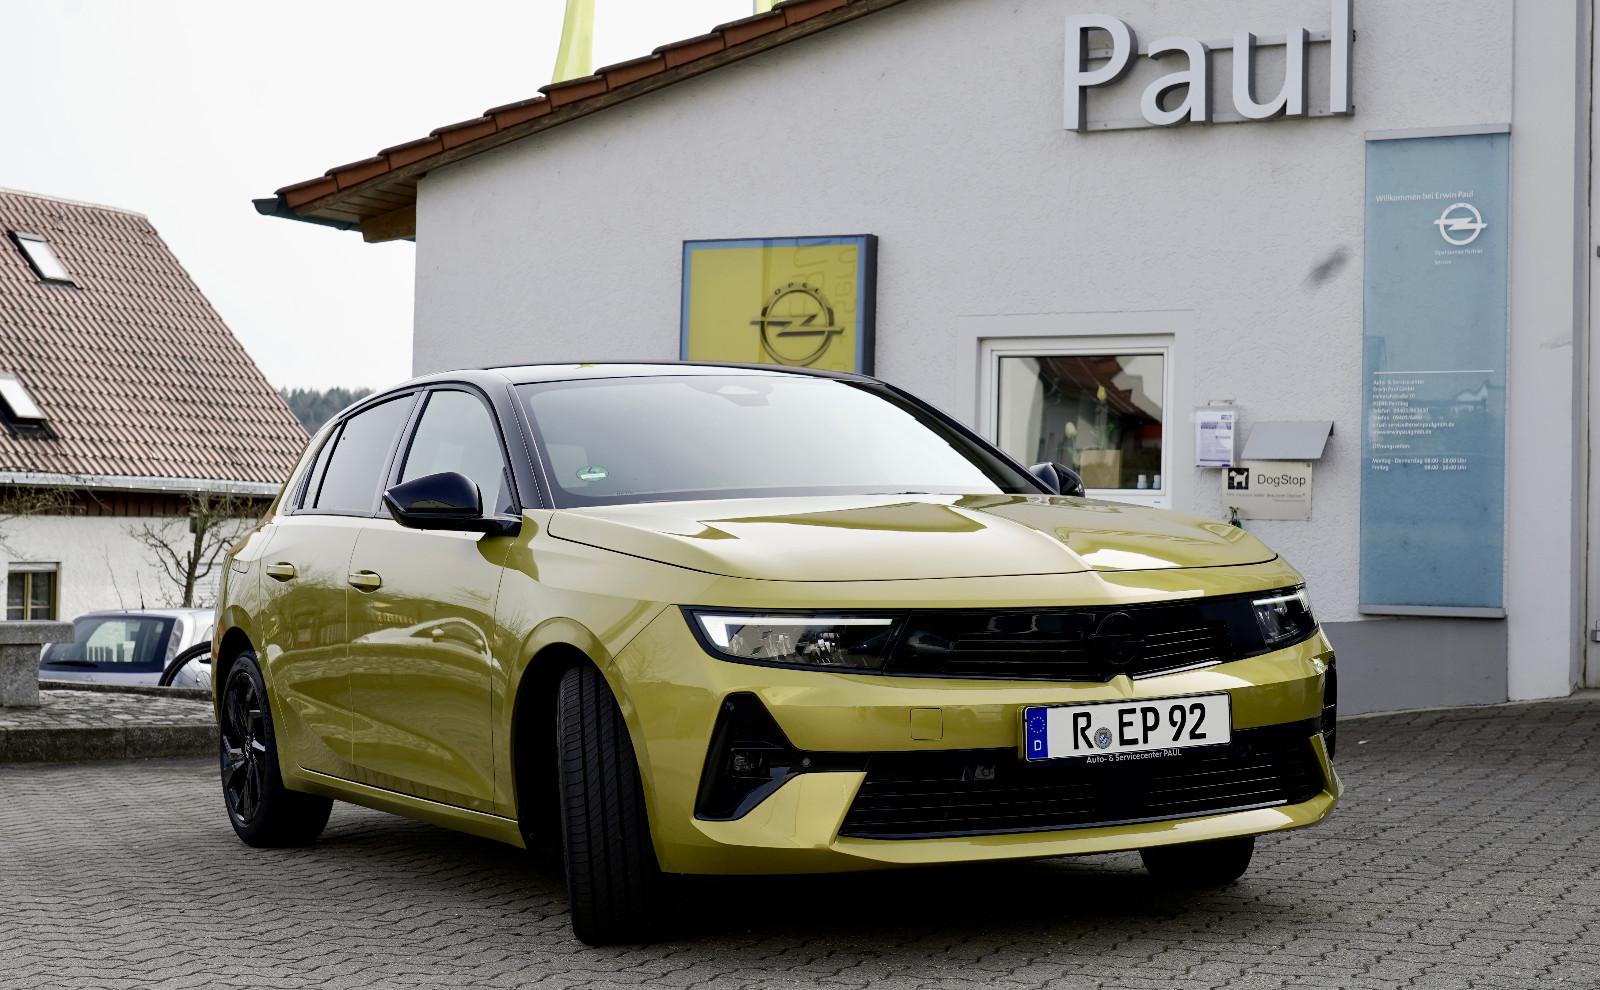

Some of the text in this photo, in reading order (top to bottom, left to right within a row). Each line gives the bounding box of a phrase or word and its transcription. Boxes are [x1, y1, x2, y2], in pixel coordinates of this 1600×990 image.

[1063, 0, 1352, 131] Paul
[1376, 190, 1474, 202] Willkommen bei Erwin Paul
[774, 282, 820, 296] OPEL
[1257, 473, 1306, 487] DogStop
[1072, 702, 1207, 750] R EP 92
[1033, 739, 1042, 751] D
[1086, 748, 1182, 764] Auto- & Servicecenter PAUL
